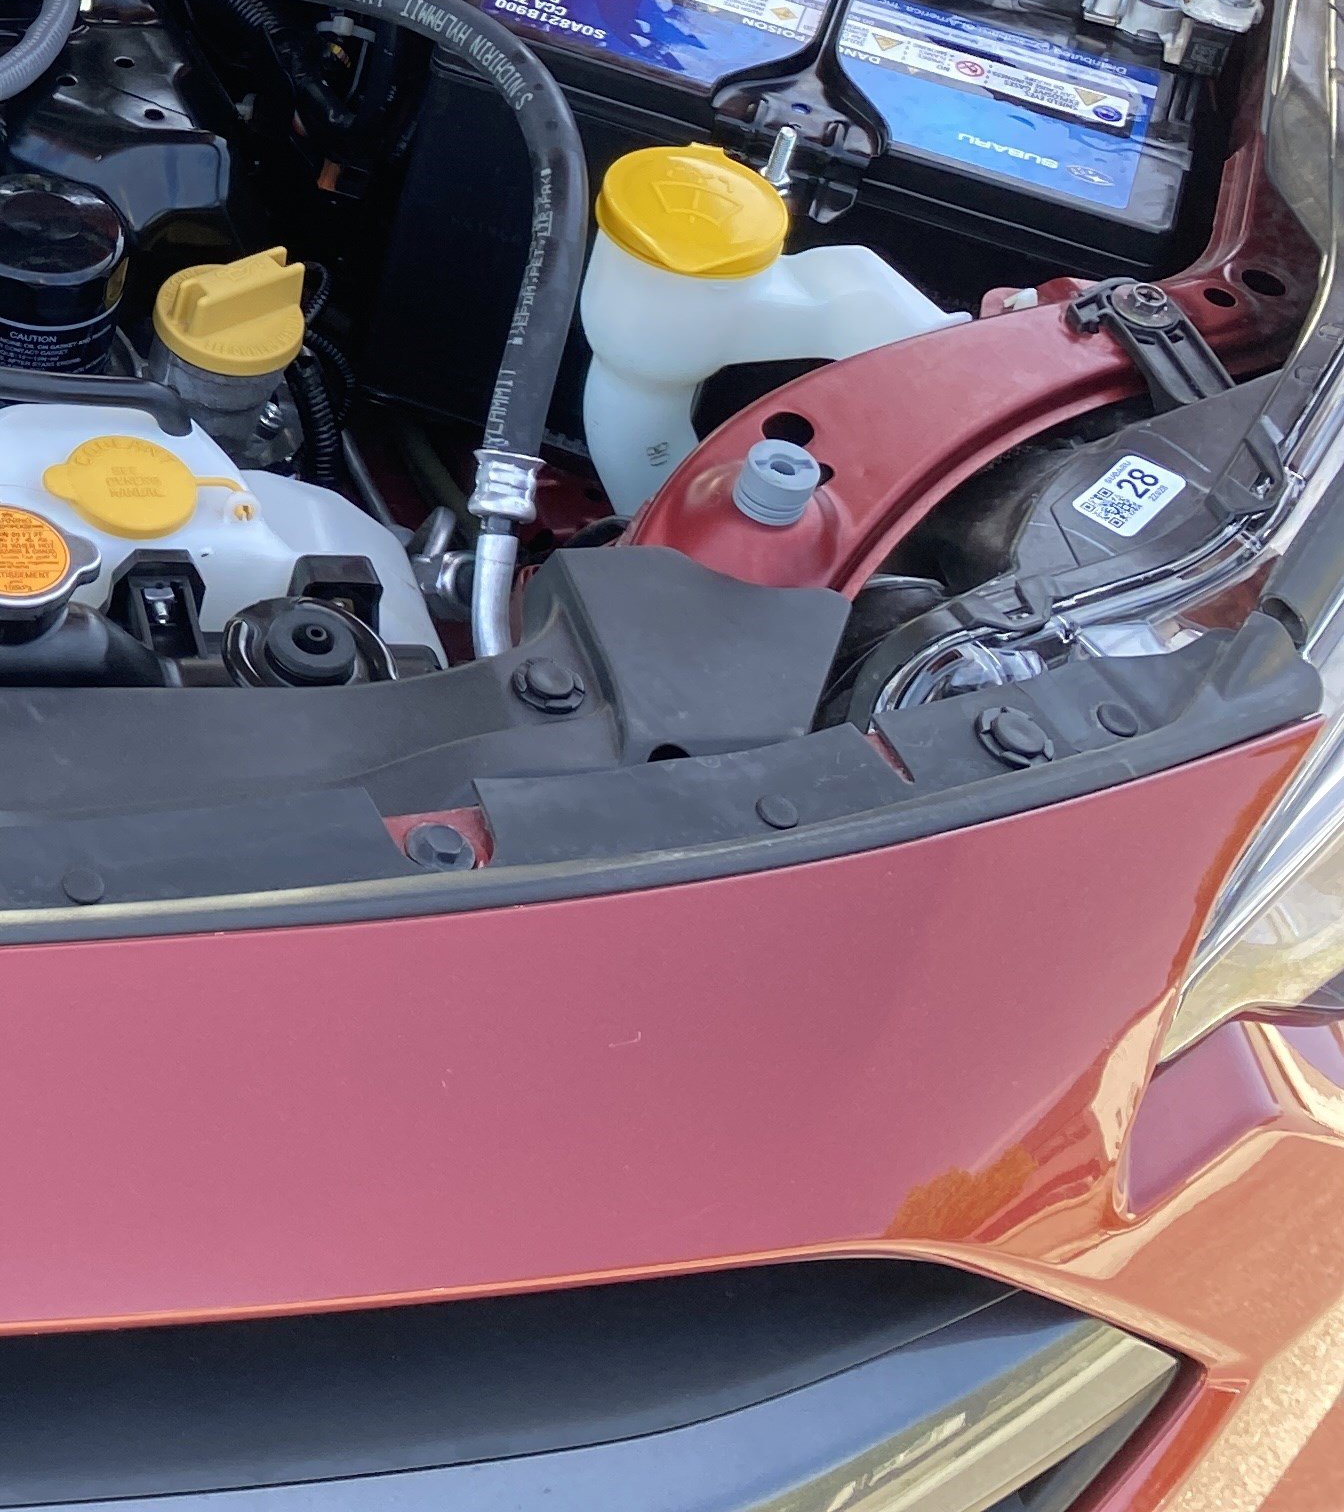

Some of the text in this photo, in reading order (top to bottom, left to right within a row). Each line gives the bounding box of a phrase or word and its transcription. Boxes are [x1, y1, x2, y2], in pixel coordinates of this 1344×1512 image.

[742, 17, 806, 42] POISON
[958, 132, 1060, 169] SUBARU
[9, 331, 58, 344] CAUTION
[1116, 468, 1159, 499] 28
